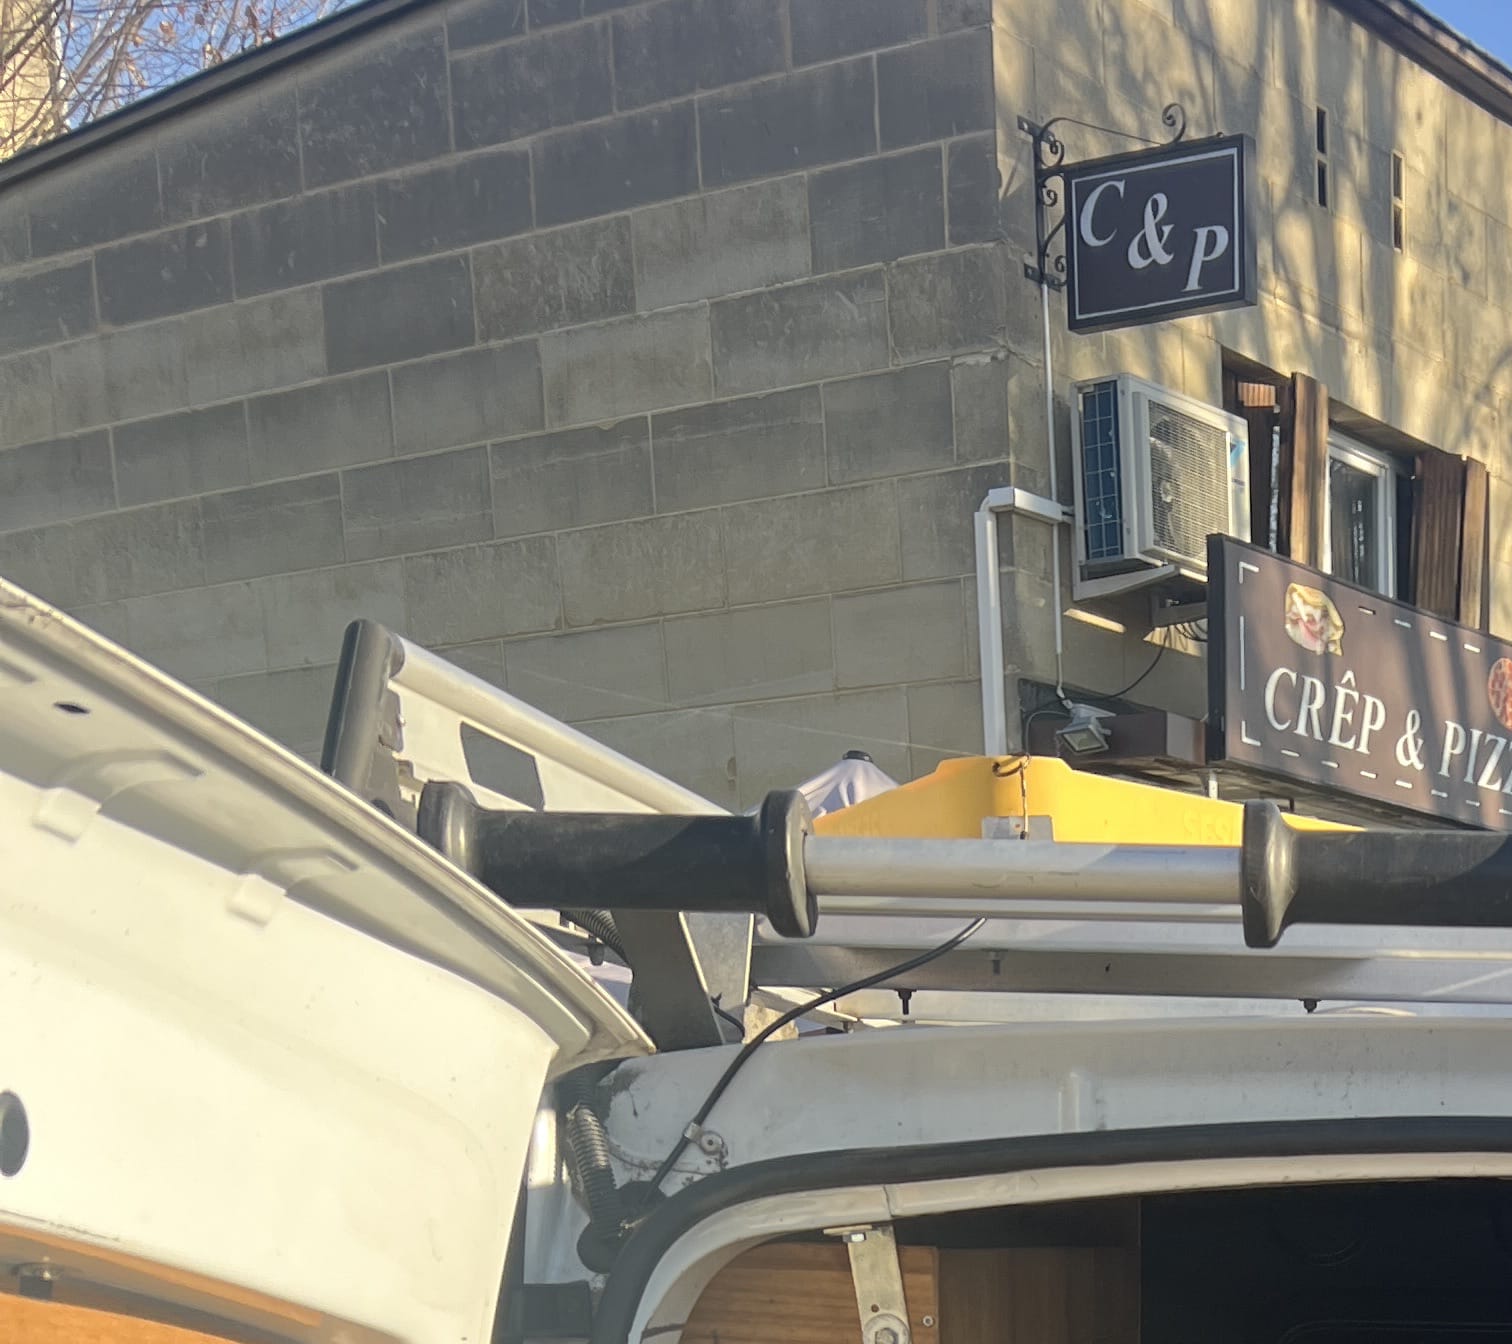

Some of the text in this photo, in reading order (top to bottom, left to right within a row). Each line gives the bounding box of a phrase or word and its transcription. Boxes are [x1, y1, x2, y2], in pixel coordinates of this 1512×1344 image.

[1080, 180, 1230, 293] C & P
[1264, 666, 1386, 754] CRÊP
[1395, 710, 1427, 769] &
